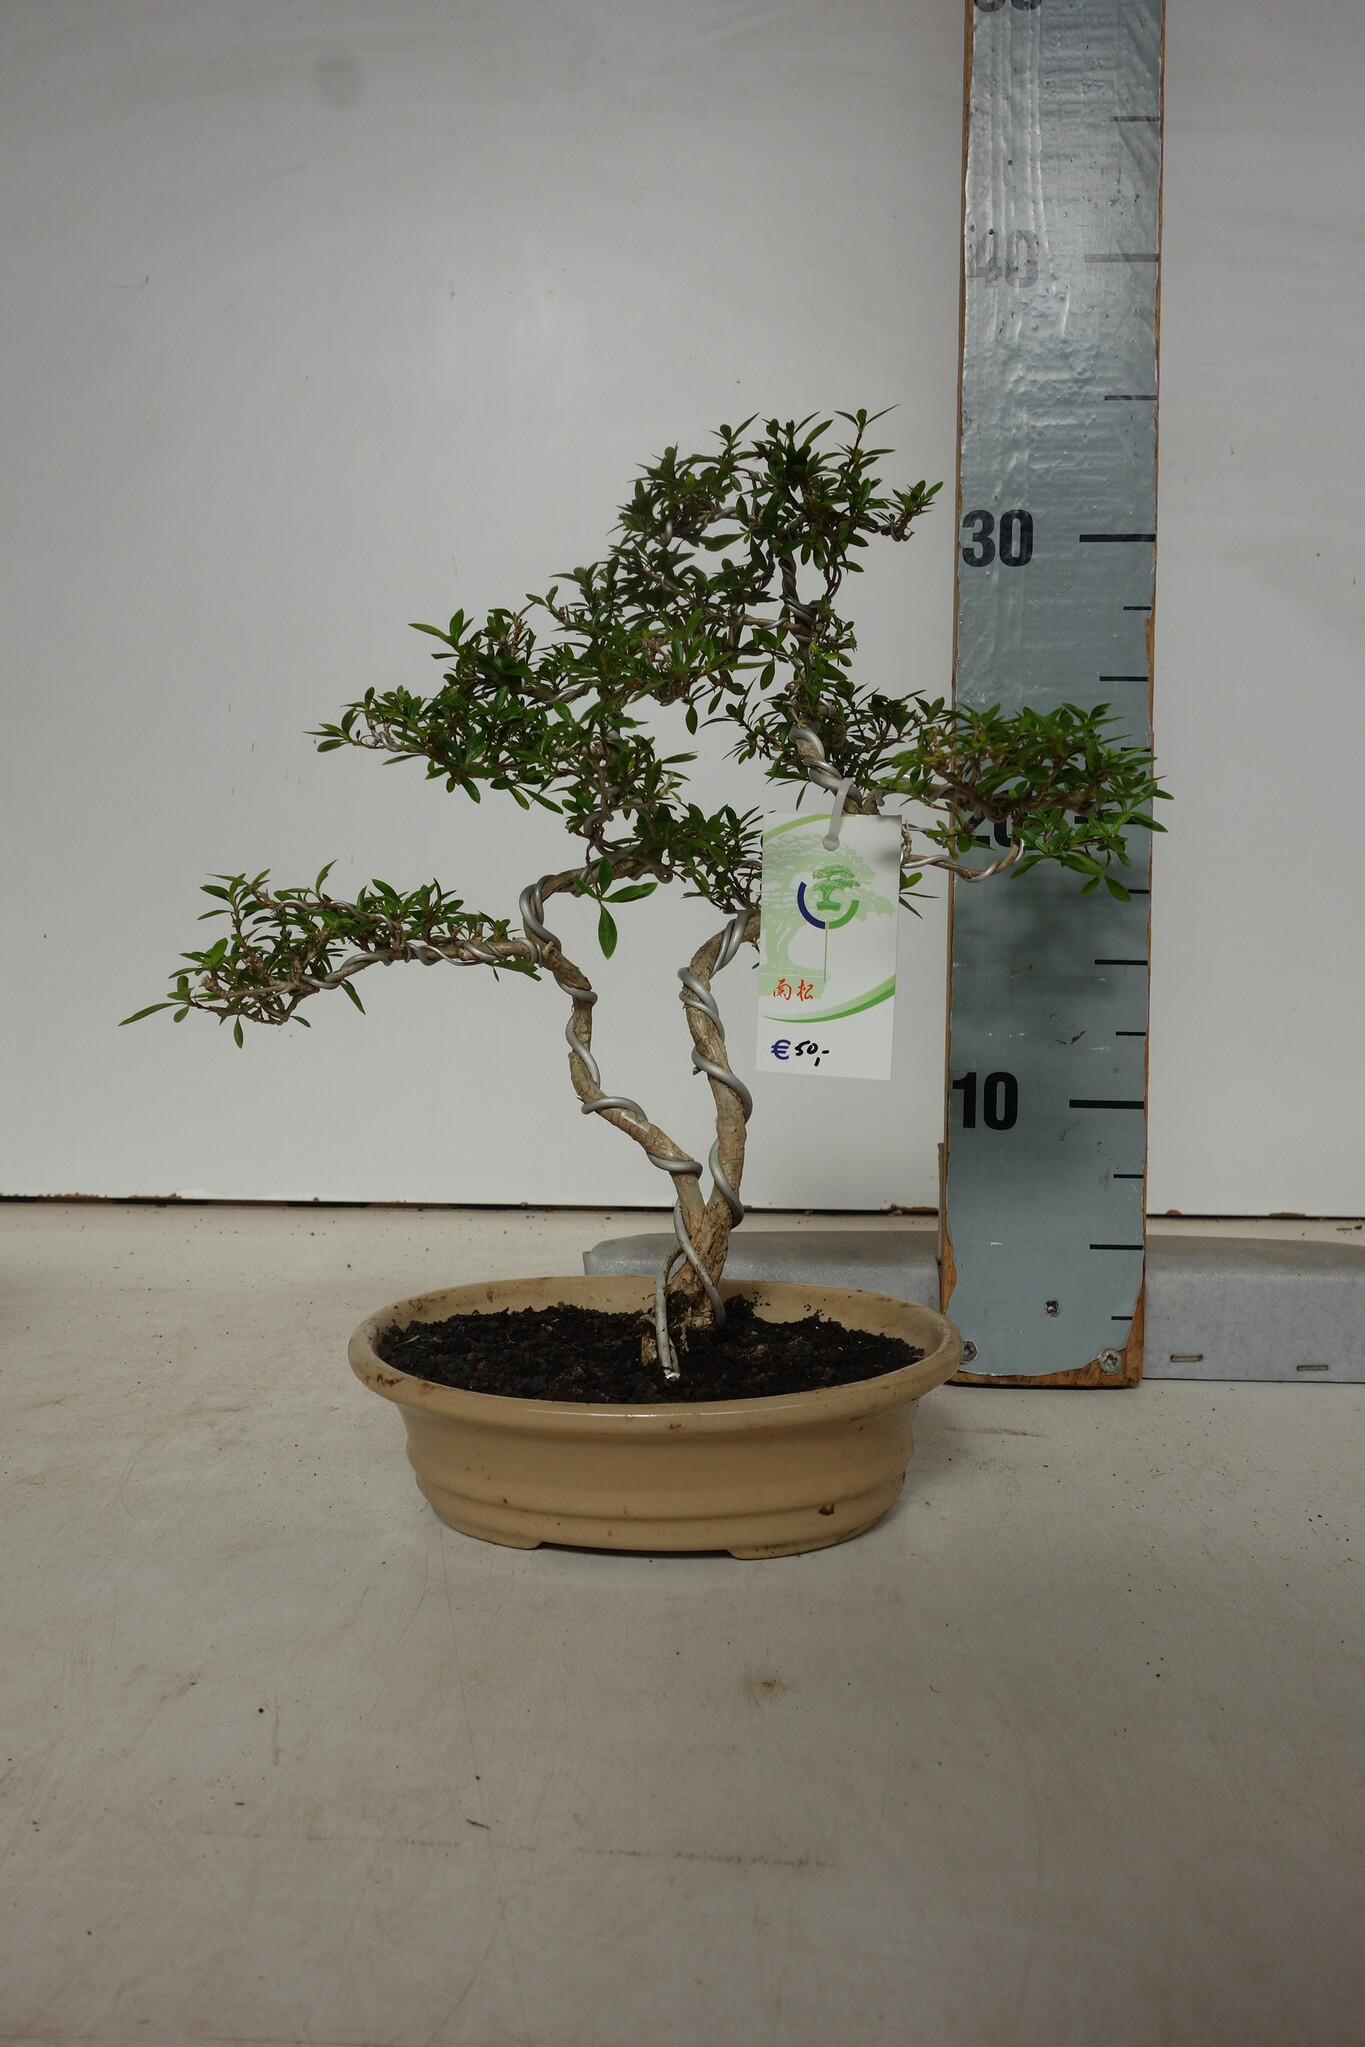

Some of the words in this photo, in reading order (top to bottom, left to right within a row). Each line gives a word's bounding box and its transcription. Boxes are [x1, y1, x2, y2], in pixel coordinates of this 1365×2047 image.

[966, 230, 1039, 288] 40
[962, 509, 1034, 567] 30
[771, 1039, 791, 1060] €
[952, 1071, 1018, 1130] 10
